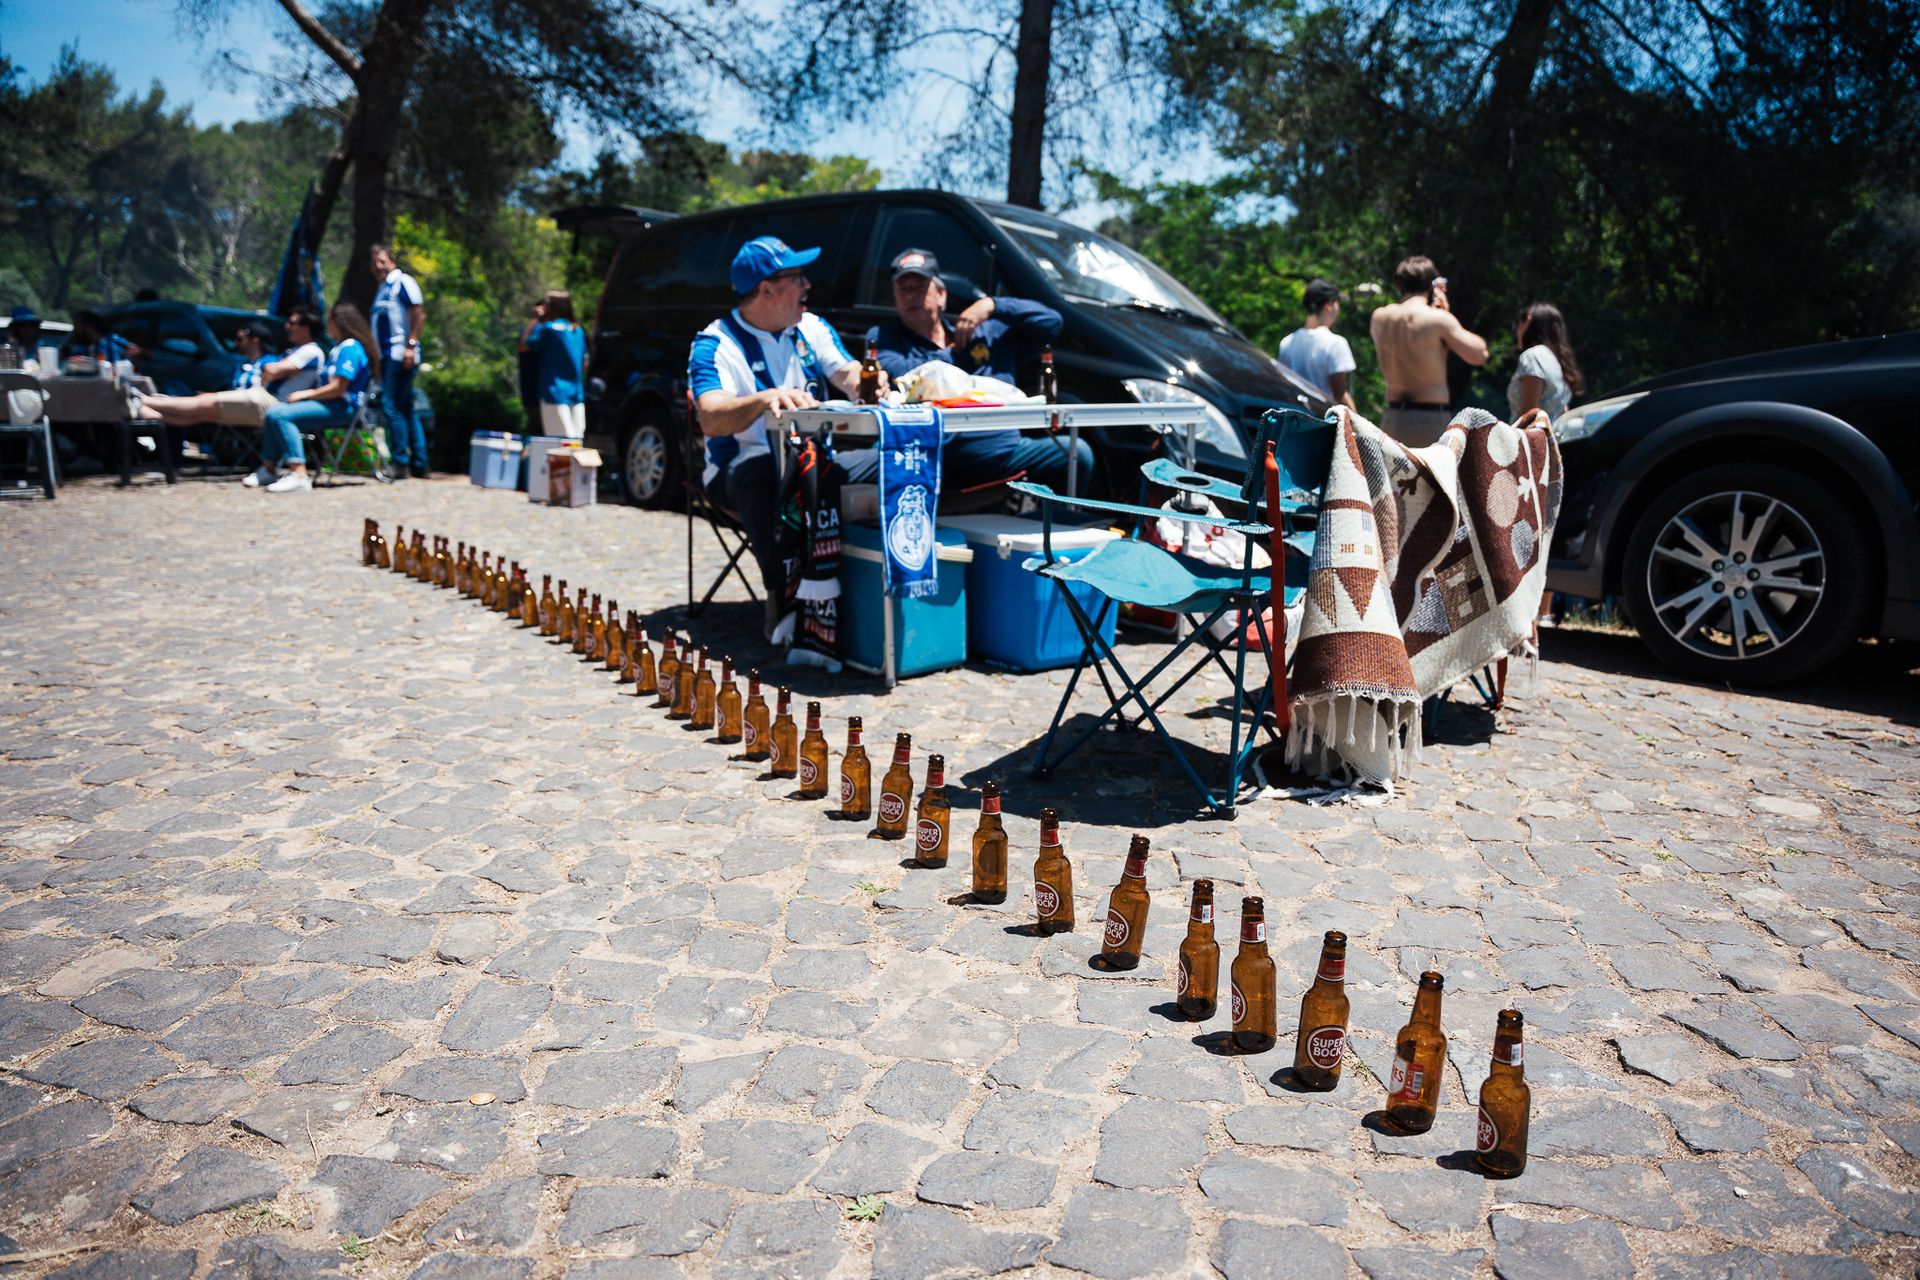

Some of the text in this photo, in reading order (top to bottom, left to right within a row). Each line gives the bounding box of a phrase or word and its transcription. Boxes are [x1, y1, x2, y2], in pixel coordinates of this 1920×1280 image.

[1105, 926, 1123, 939] OCK
[1312, 1037, 1344, 1048] SUPER
[1313, 1046, 1342, 1057] BOCK
